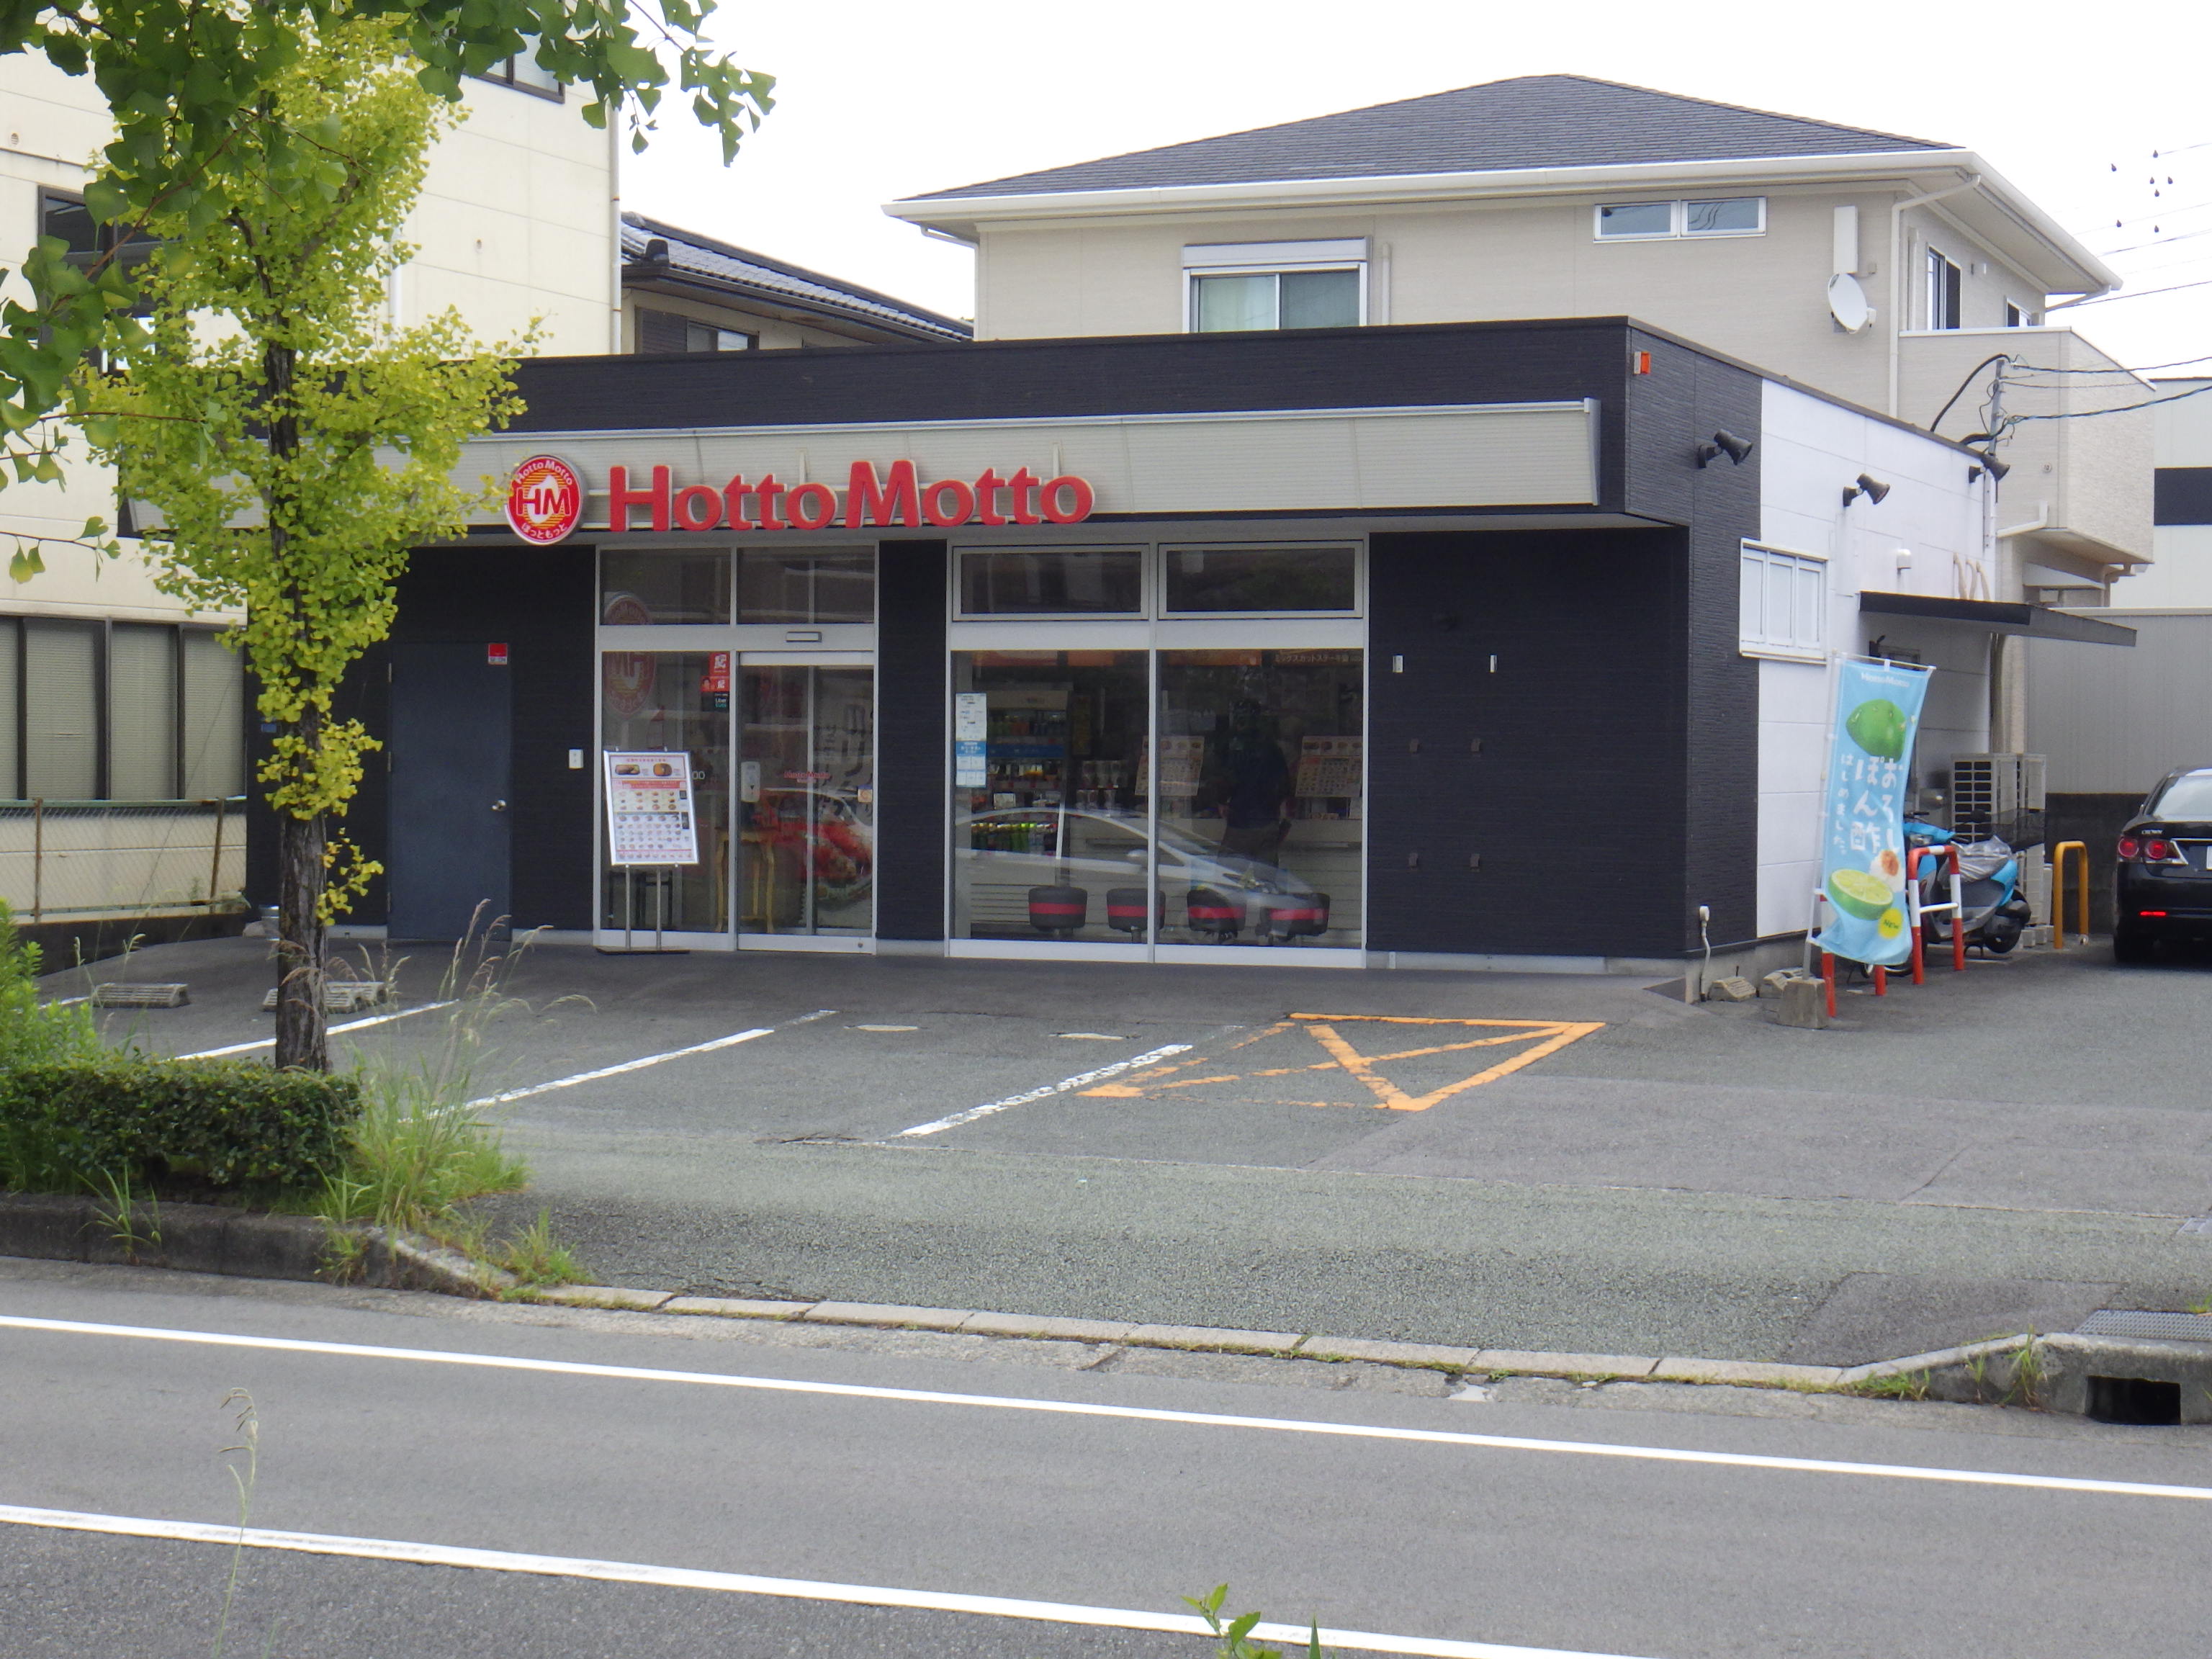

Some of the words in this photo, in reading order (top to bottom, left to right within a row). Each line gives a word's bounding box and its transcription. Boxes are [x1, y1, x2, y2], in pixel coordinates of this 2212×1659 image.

[516, 487, 572, 516] HM
[1850, 756, 1884, 854] ぽん酢
[1881, 757, 1903, 852] おろし
